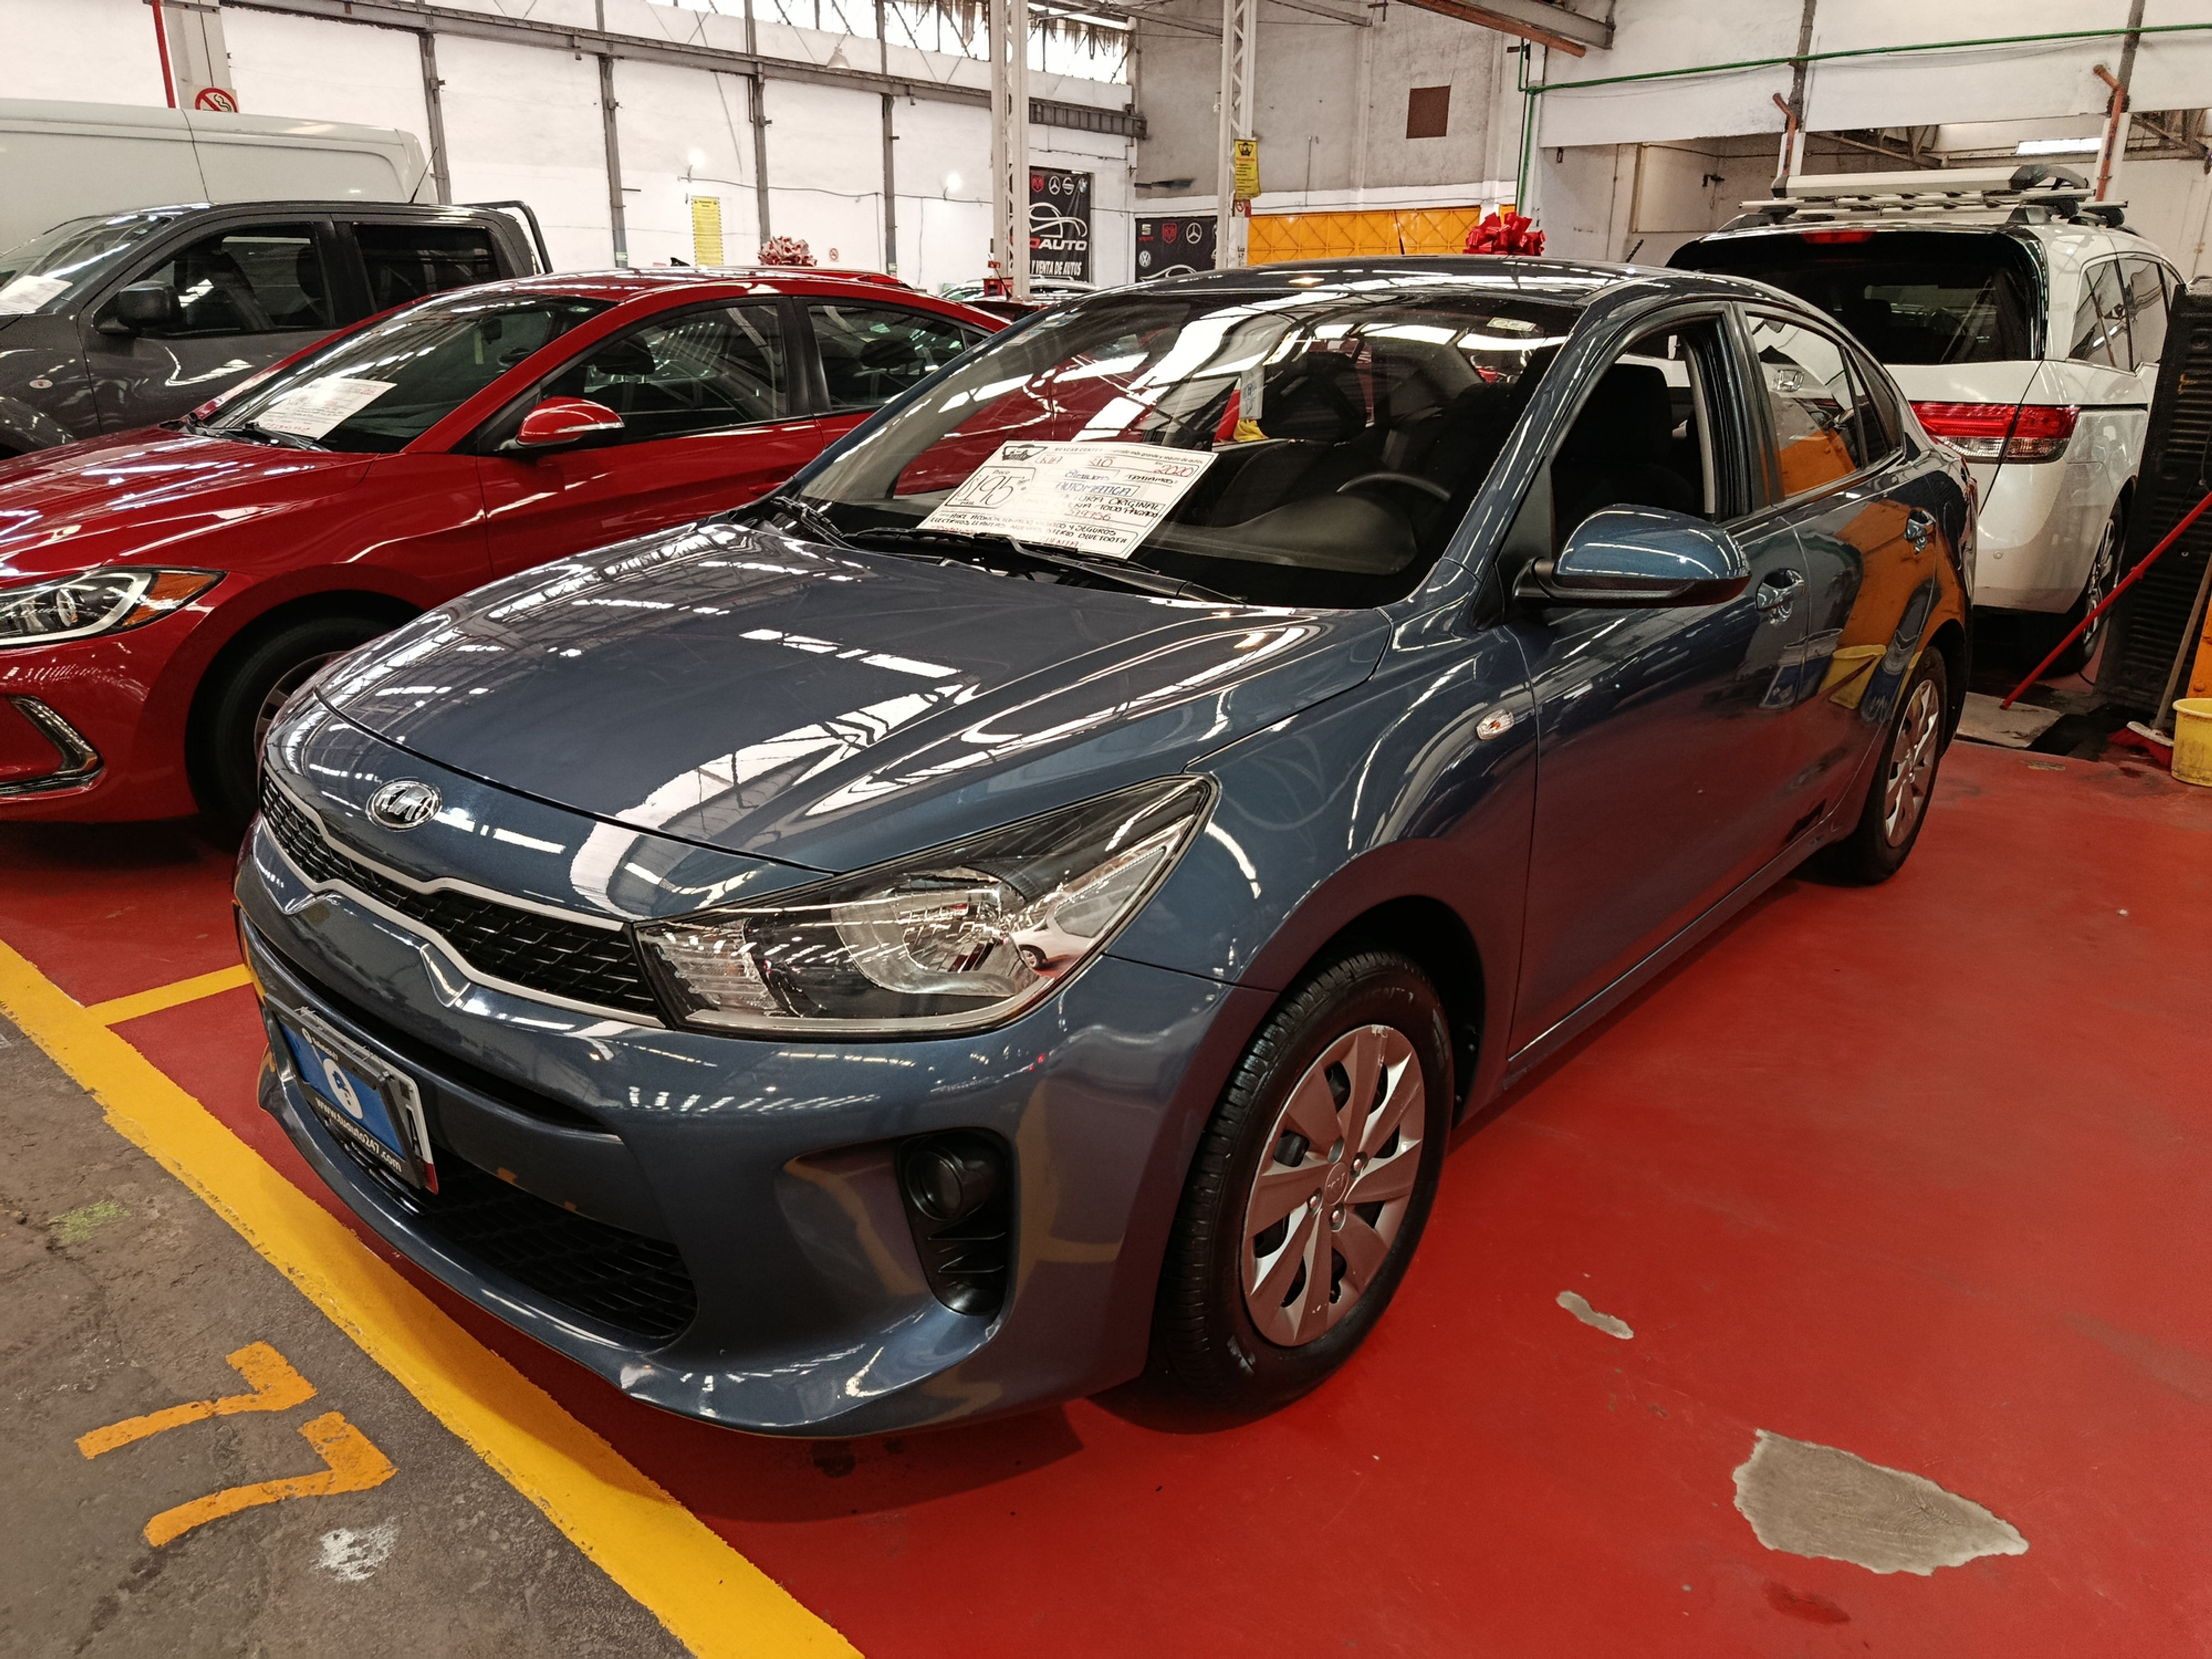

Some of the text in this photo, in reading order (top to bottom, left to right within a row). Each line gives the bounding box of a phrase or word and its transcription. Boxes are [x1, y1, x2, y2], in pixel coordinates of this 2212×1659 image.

[1036, 260, 1053, 275] VENTA
[1054, 261, 1063, 275] DE
[1063, 262, 1082, 276] AUTOS
[1154, 464, 1194, 477] 2020
[1108, 497, 1160, 510] ORIGINAL
